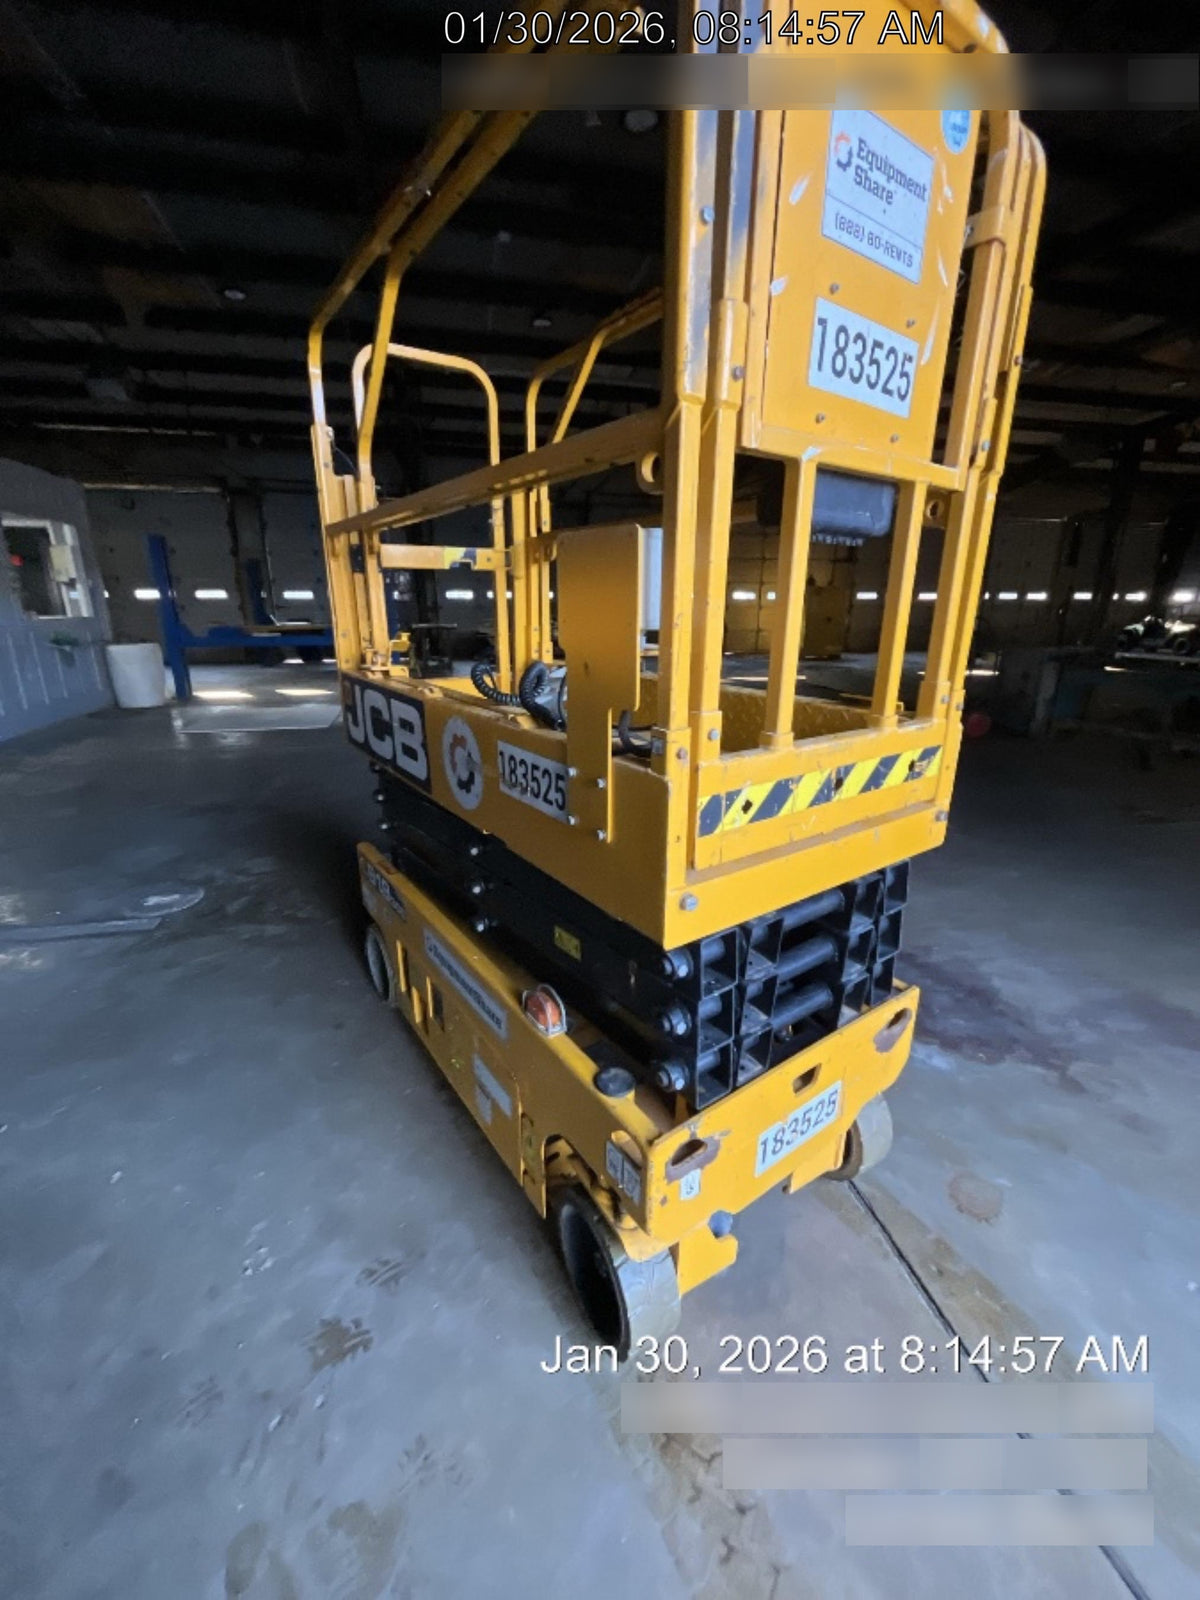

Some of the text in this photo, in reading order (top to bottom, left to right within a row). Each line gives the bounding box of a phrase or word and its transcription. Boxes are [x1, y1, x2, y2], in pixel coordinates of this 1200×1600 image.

[854, 164, 894, 205] Share
[856, 137, 927, 202] Equipment
[817, 317, 914, 402] 183525
[347, 683, 428, 781] JCB
[499, 750, 566, 811] 183525
[759, 1089, 839, 1165] 183525
